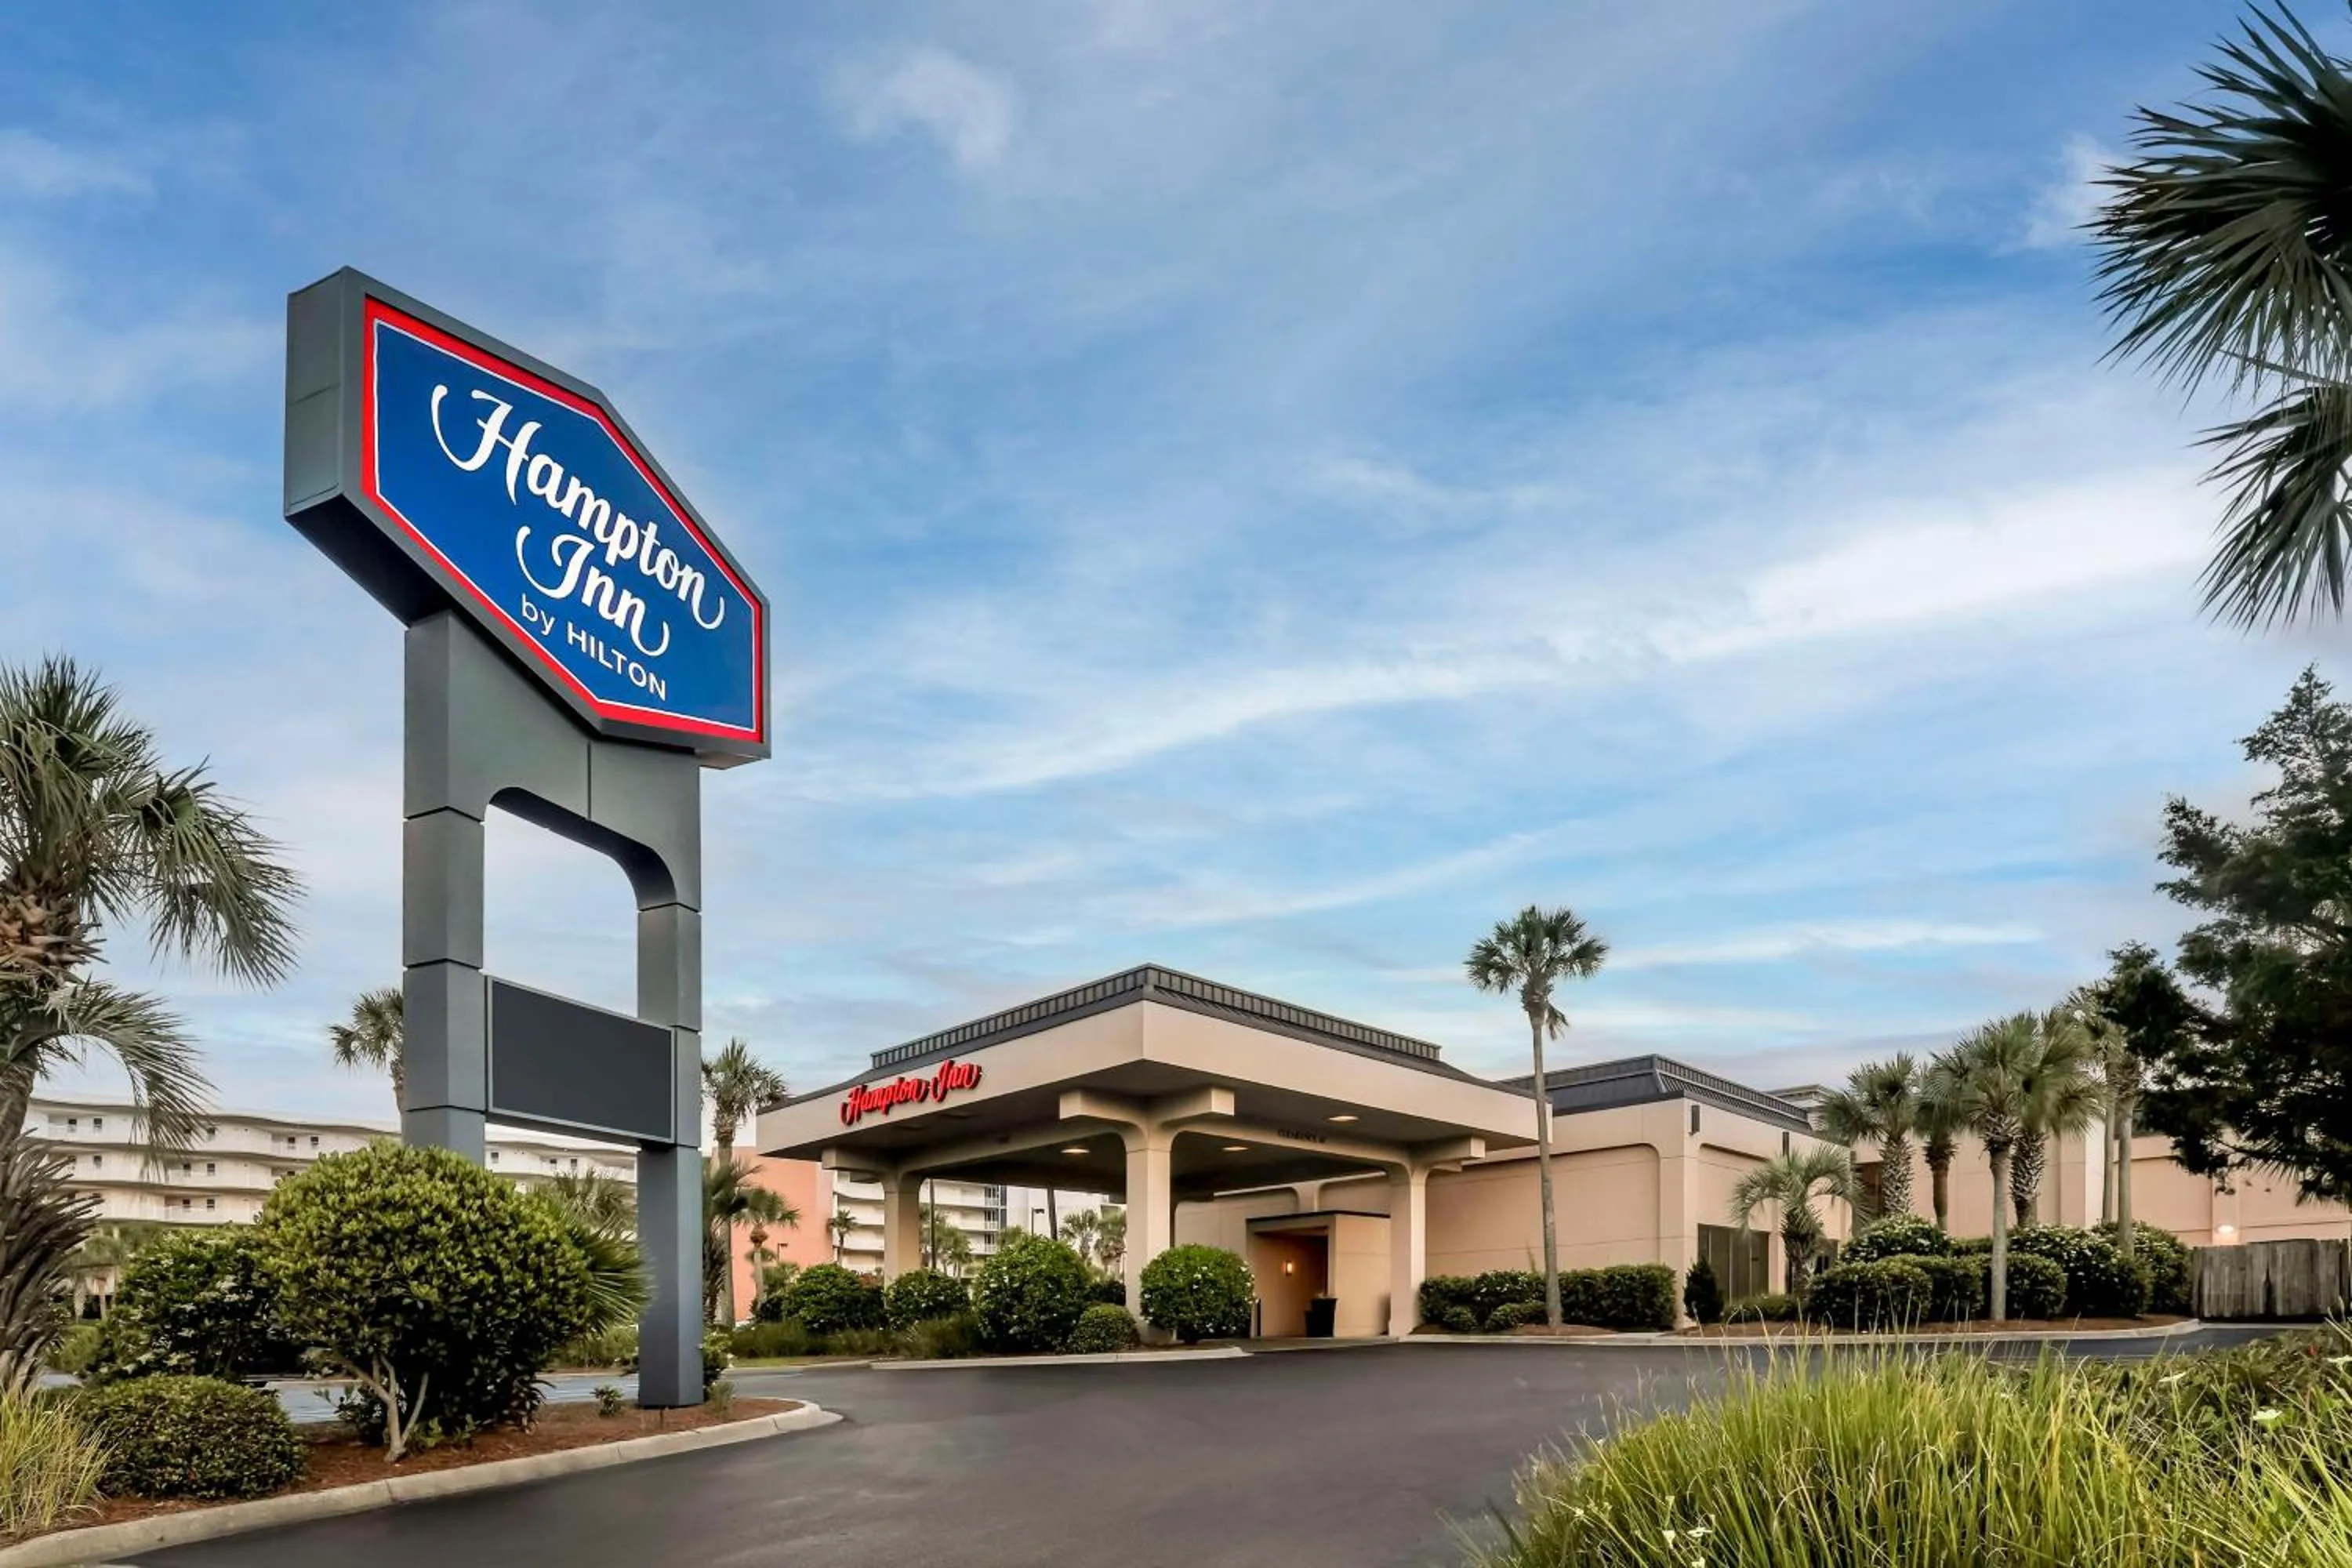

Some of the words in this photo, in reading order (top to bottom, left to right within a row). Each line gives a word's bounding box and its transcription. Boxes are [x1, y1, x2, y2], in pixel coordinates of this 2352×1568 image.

[430, 384, 725, 630] Hampton
[515, 525, 670, 656] Inn
[521, 593, 555, 636] by
[567, 622, 666, 701] HILTON
[840, 1077, 928, 1125] Hampton
[930, 1059, 982, 1102] Inn
